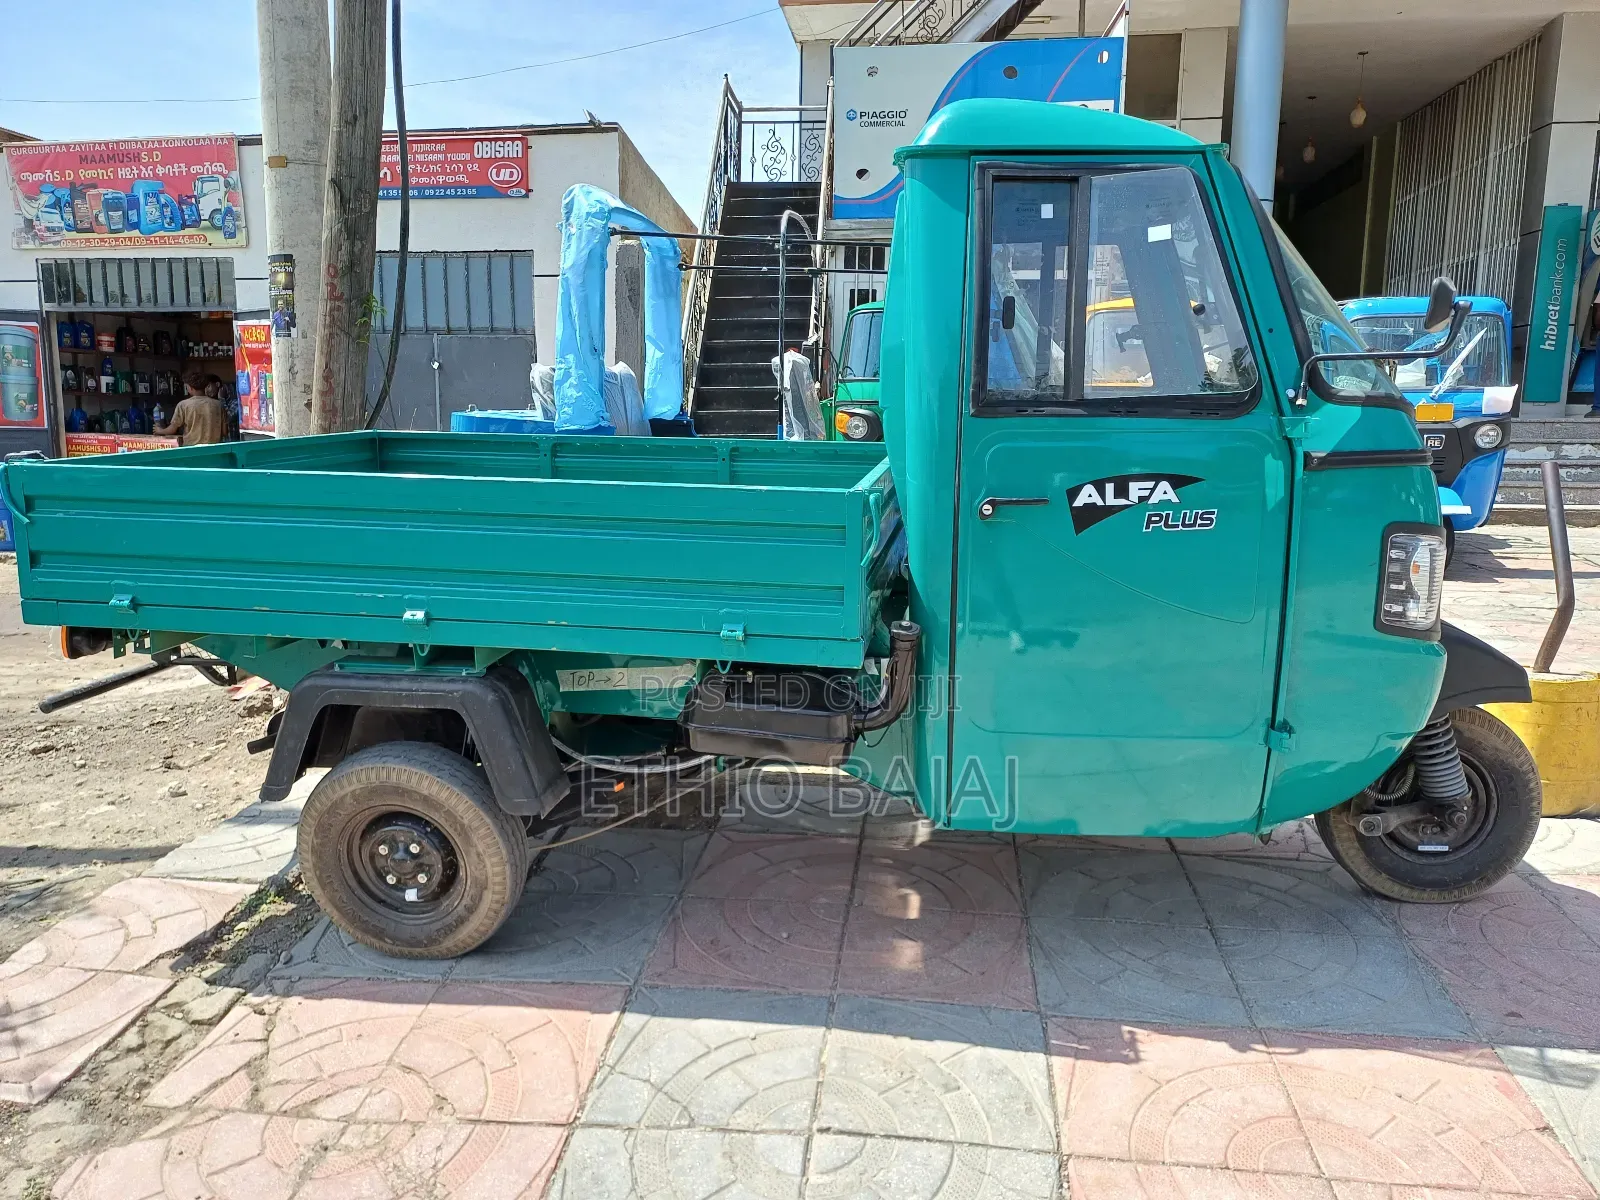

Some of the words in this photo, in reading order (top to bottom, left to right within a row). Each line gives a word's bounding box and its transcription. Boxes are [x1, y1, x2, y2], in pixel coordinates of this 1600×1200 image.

[859, 110, 907, 119] PIAGGIO
[11, 144, 67, 156] GURGUURTAA
[69, 143, 107, 152] ZAYITAA
[109, 142, 117, 150] FI
[119, 140, 159, 150] DIIBATAA
[162, 137, 229, 148] KONKOLAATAA
[474, 140, 523, 158] OBISAA
[491, 168, 519, 181] UD
[1540, 238, 1567, 351] hibretbank.com
[67, 444, 111, 453] AAMUSH(S.D)
[1427, 439, 1442, 447] RE
[1072, 480, 1181, 507] ALFA
[1142, 508, 1218, 532] PLUS
